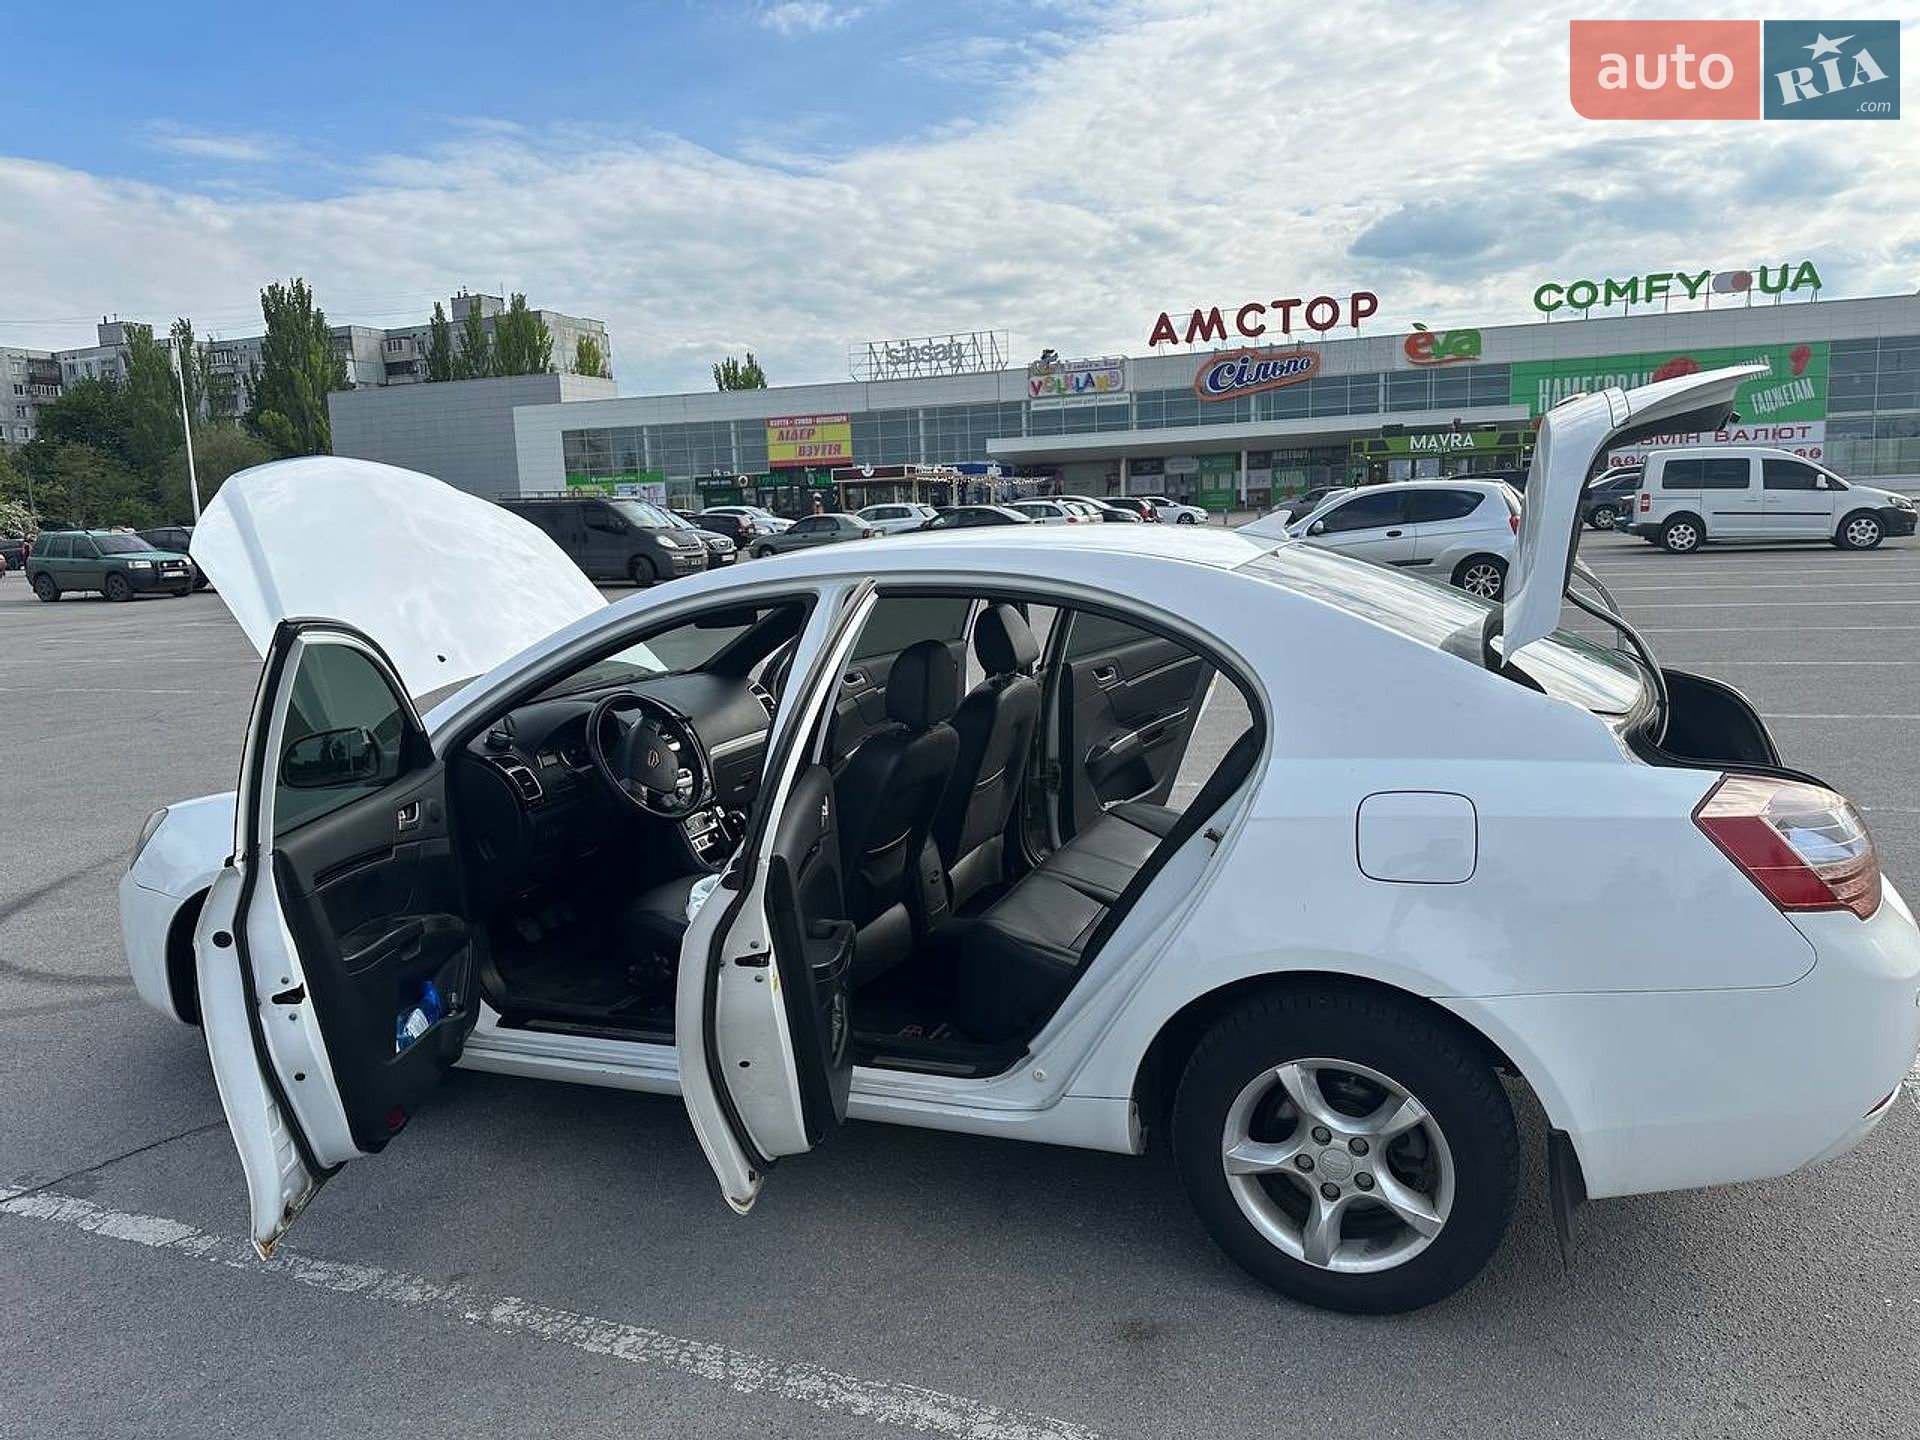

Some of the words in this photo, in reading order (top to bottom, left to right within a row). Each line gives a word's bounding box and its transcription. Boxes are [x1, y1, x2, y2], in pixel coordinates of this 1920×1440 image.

[1534, 269, 1711, 312] COMFY
[1758, 260, 1823, 294] UA
[1149, 292, 1379, 347] АМСТОР
[1208, 356, 1313, 392] Сільпо
[1751, 378, 1815, 415] ГАДЖЕТАМ
[1409, 432, 1475, 450] MAVRA
[1714, 425, 1812, 442] ВАЛЮТ
